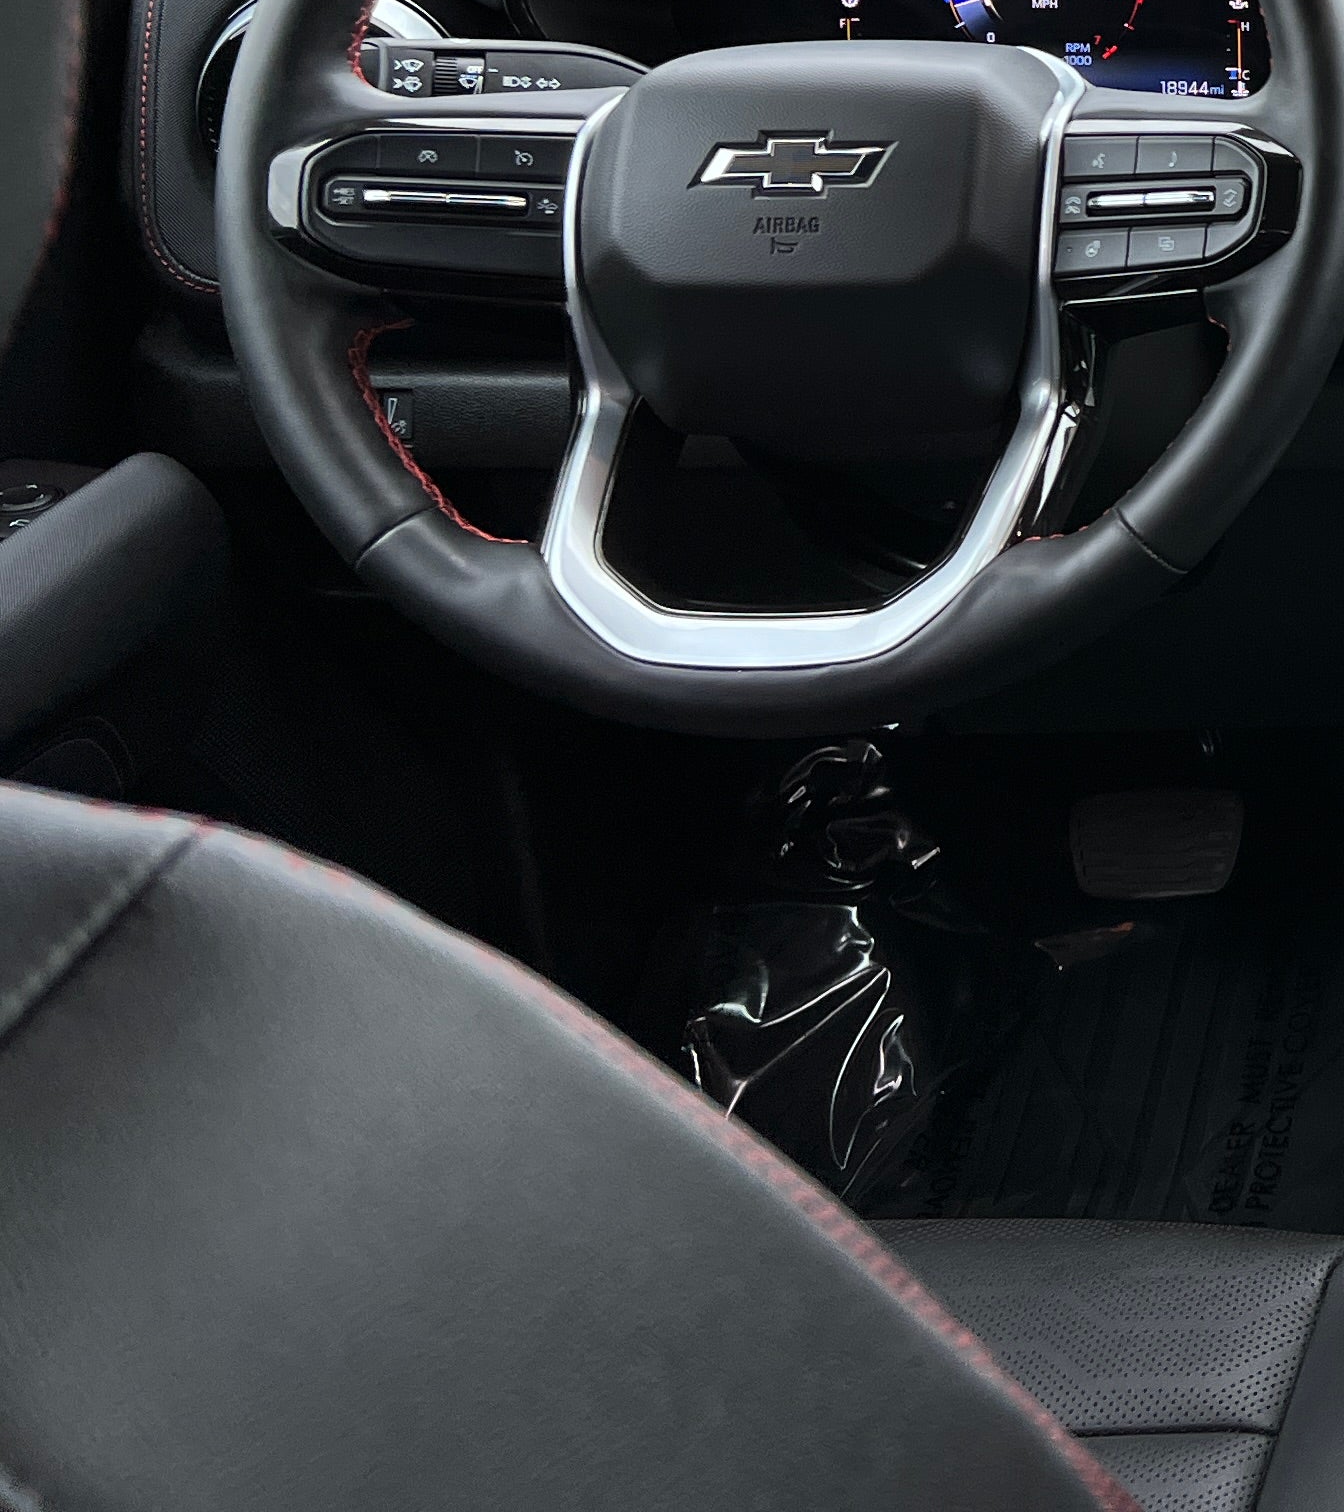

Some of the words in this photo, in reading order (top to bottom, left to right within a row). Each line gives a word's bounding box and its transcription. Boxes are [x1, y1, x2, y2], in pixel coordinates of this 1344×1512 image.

[839, 18, 847, 29] F
[1241, 22, 1250, 31] H
[986, 32, 996, 43] 0
[1065, 43, 1091, 53] RPM
[1063, 55, 1093, 66] 1000
[1242, 70, 1251, 81] C
[1160, 80, 1209, 96] 18944
[1209, 85, 1225, 95] mi
[753, 216, 820, 235] AIRBAG
[1207, 1121, 1256, 1215] DEALER
[1237, 1036, 1273, 1105] MUST
[1243, 1061, 1305, 1212] PROTECTIVE
